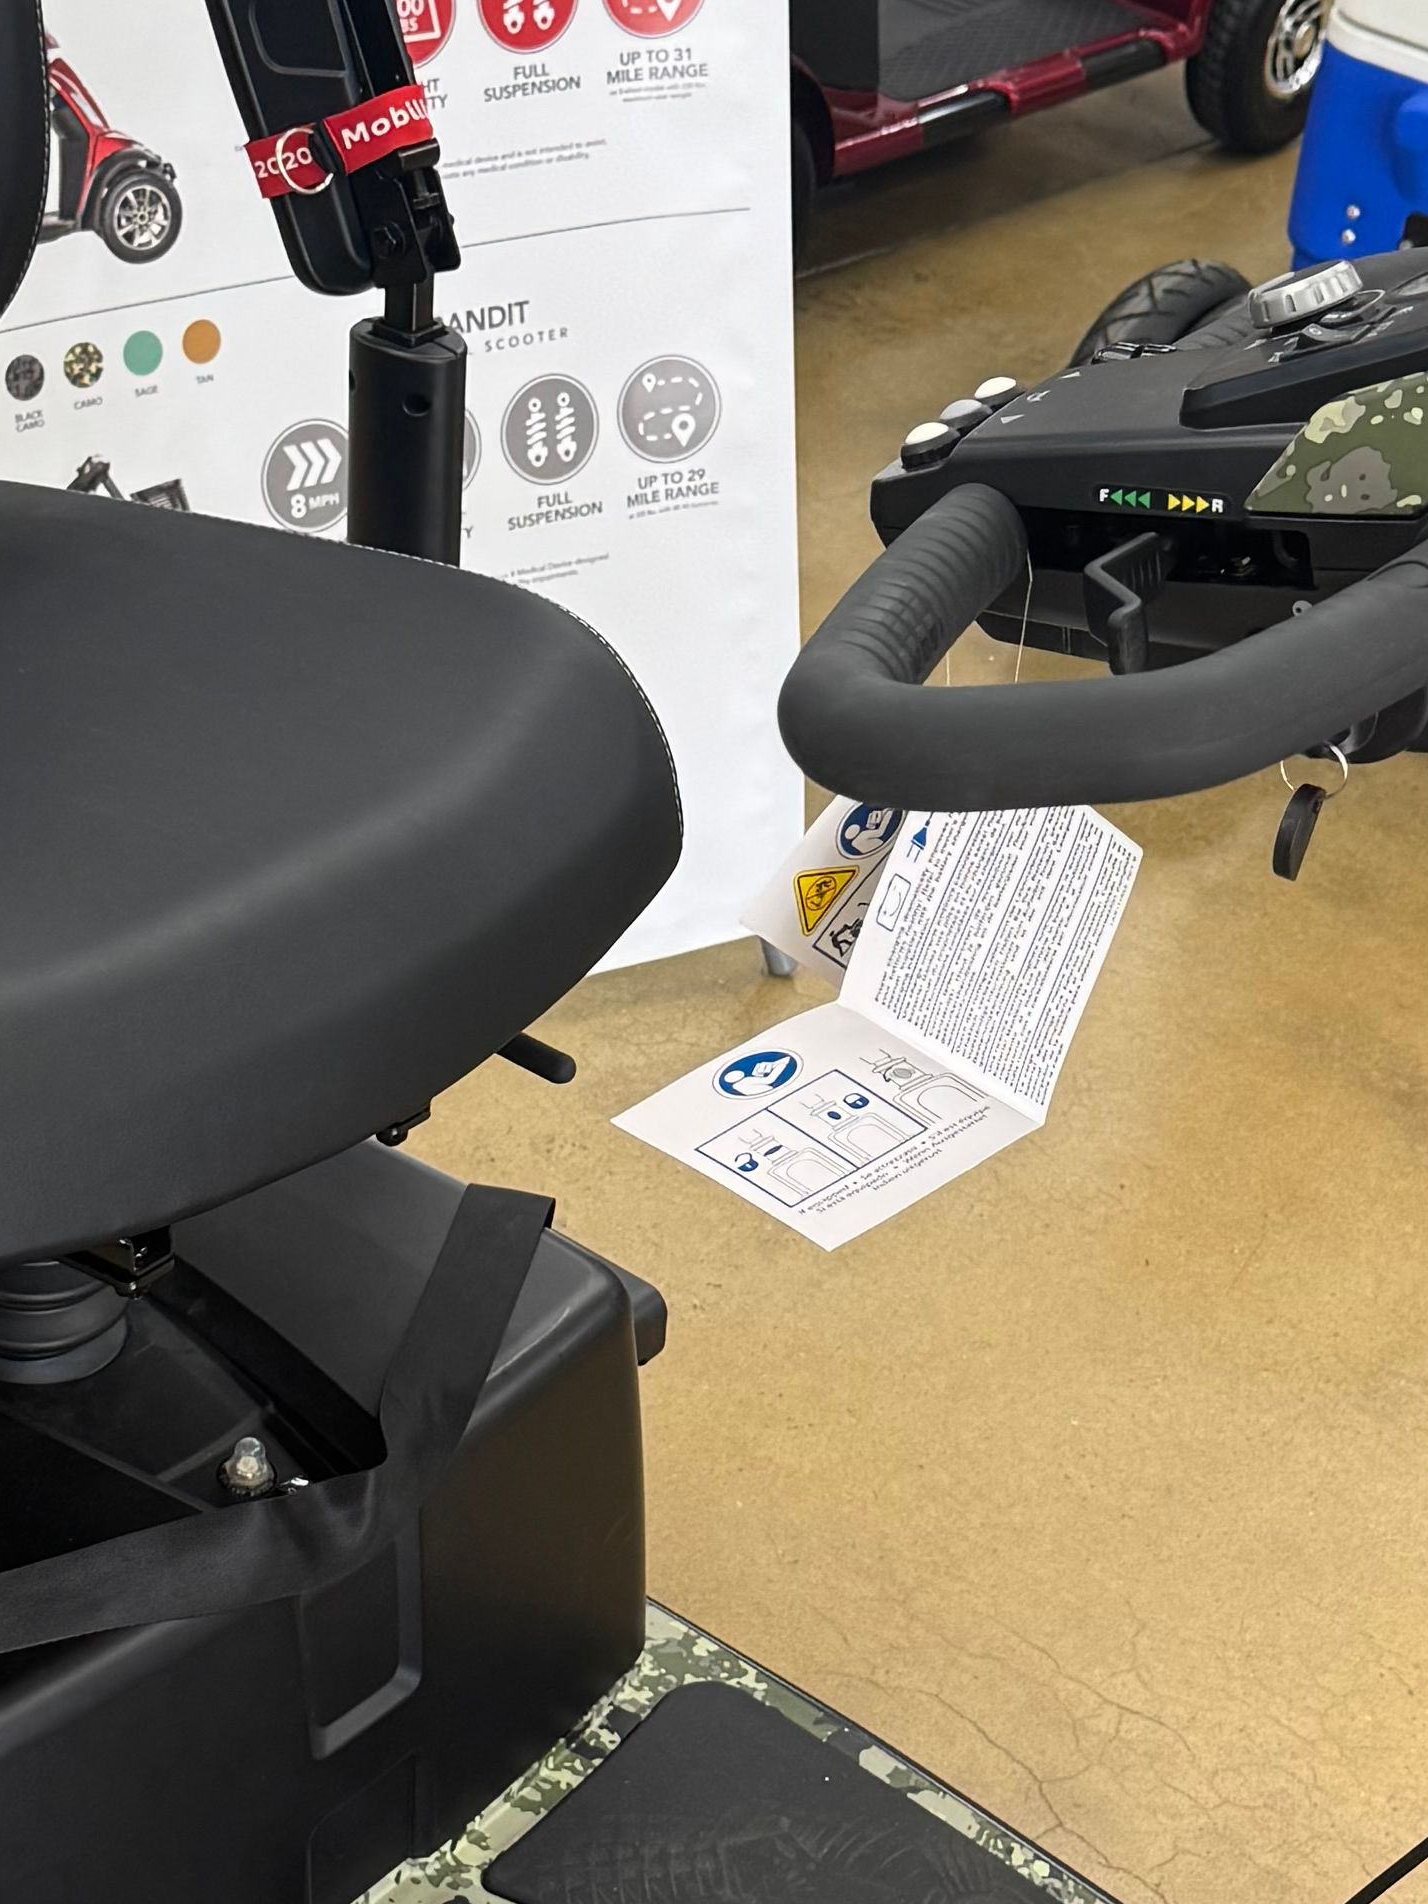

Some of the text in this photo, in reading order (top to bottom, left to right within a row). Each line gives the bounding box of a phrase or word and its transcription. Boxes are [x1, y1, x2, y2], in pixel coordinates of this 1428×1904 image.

[400, 16, 419, 33] BS
[619, 47, 692, 66] UP TO 31
[513, 63, 550, 81] FULL
[606, 63, 709, 85] MILE RANGE
[483, 76, 581, 102] SUSPENSION
[448, 299, 530, 334] ANDIT
[484, 326, 569, 353] SCOOTER
[195, 374, 214, 385] TAN
[73, 396, 103, 410] CAMO
[15, 409, 43, 424] BLACK
[15, 419, 45, 433] CAMO
[637, 468, 706, 490] UP TO 29
[537, 491, 573, 509] FULL
[626, 481, 720, 508] MILE RANGE
[1099, 488, 1110, 502] F
[290, 492, 340, 519] 8 MPH
[1211, 498, 1224, 513] R
[507, 500, 603, 531] SUSPENSION
